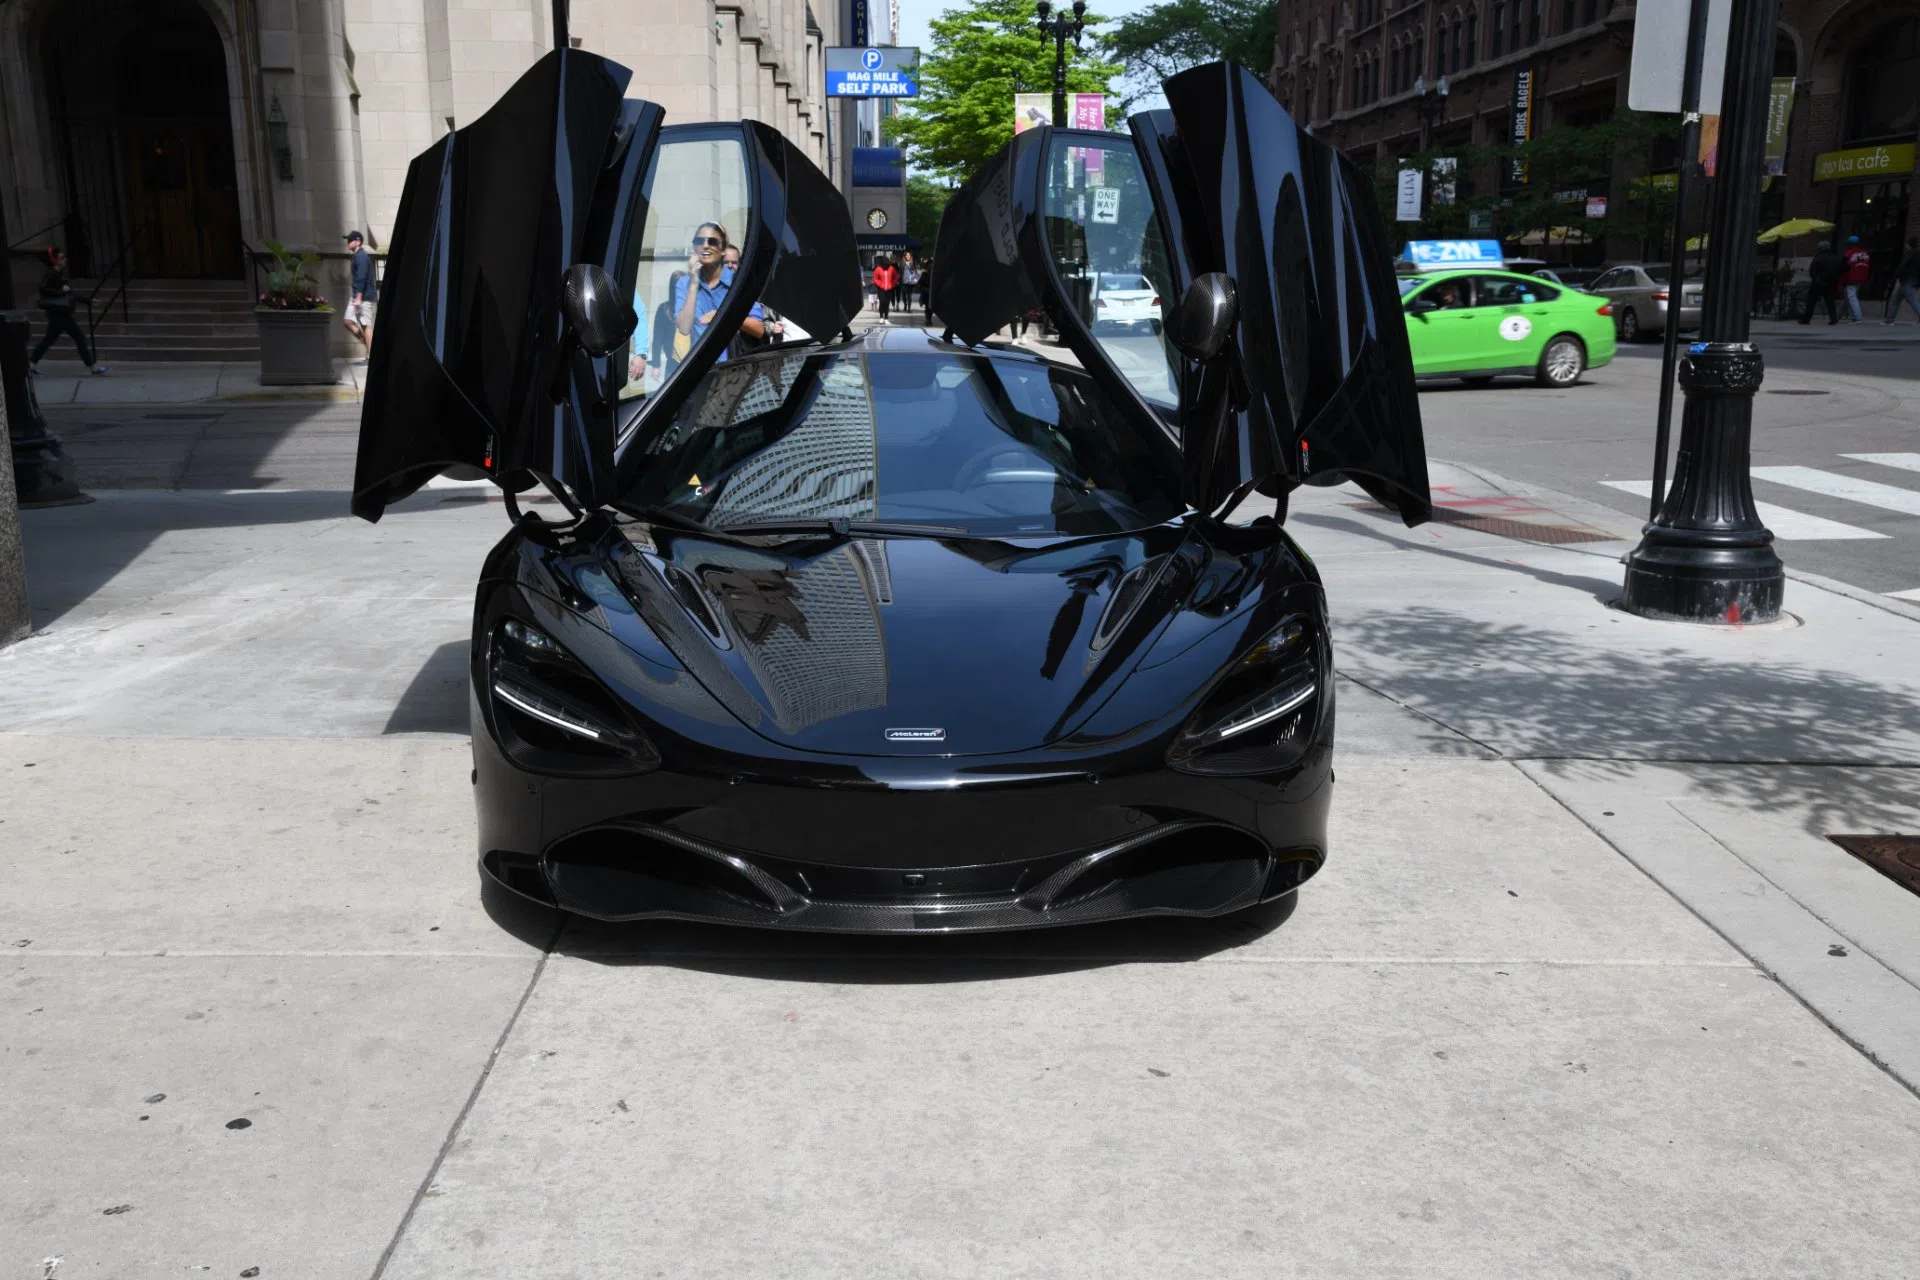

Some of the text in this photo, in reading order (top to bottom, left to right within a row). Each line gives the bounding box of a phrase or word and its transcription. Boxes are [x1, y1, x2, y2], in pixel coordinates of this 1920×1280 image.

[866, 51, 879, 68] P
[847, 72, 899, 81] MAG MILE
[837, 82, 908, 94] SELF PARK
[1517, 71, 1530, 108] BAGELS
[1077, 106, 1087, 121] My
[1089, 107, 1098, 124] Her
[1856, 147, 1890, 169] café
[1098, 191, 1116, 200] ONE
